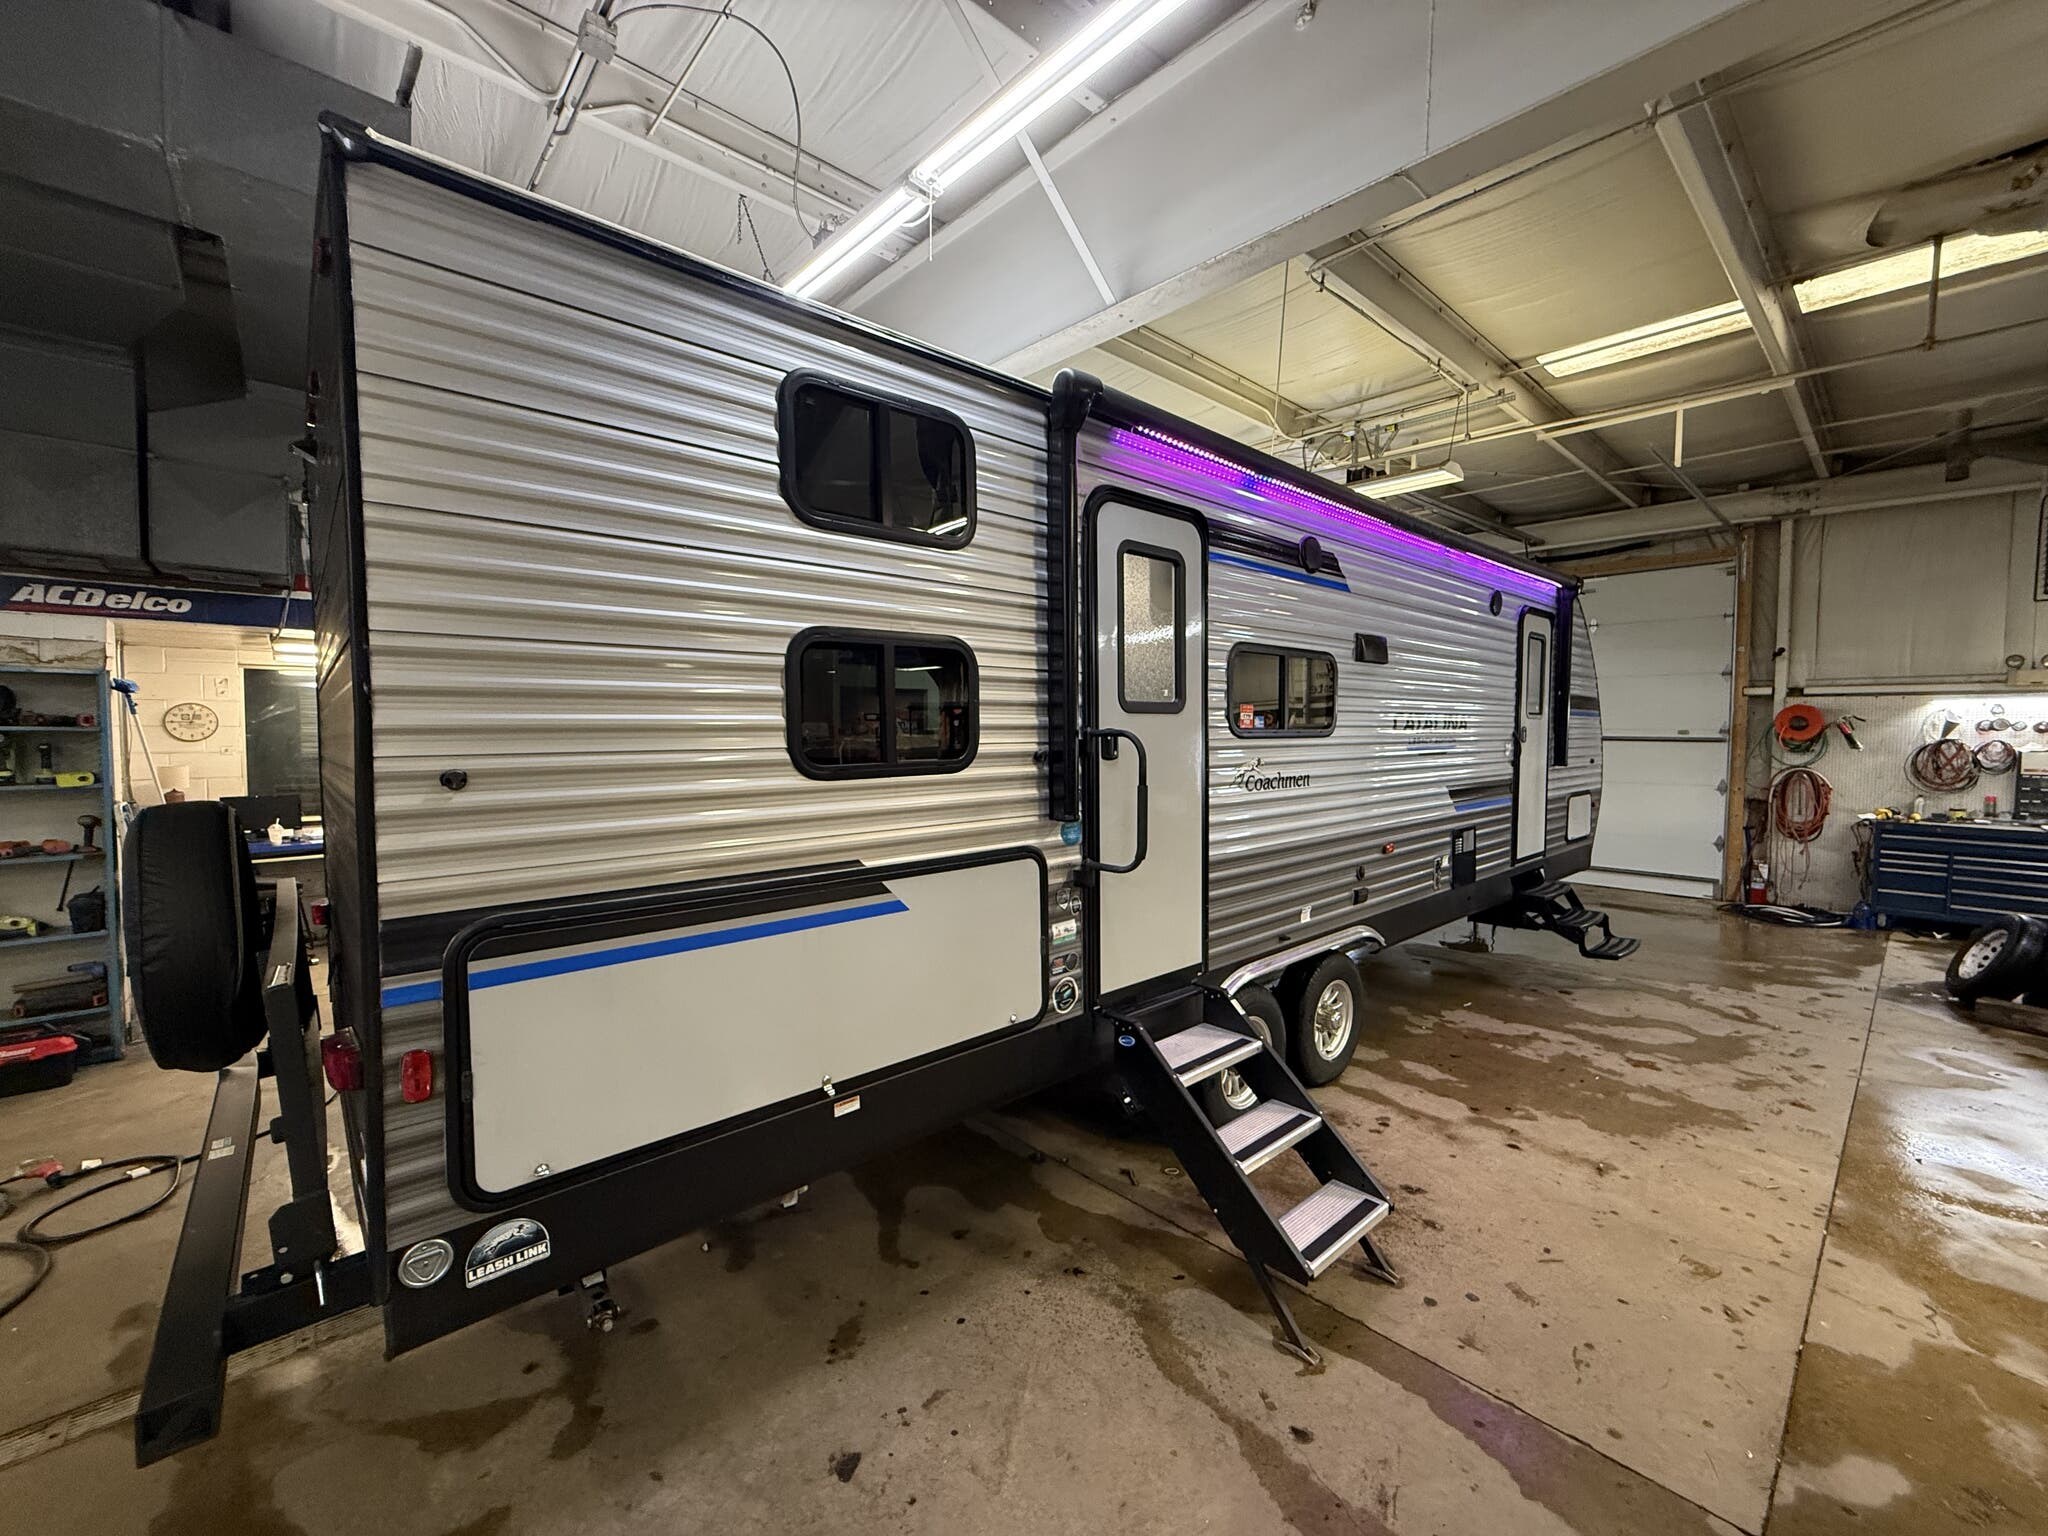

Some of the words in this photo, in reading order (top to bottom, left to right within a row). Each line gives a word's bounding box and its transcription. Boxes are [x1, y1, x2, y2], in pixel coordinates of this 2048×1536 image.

[10, 583, 192, 613] ACDelco
[1245, 772, 1310, 792] Coachmen
[468, 1256, 513, 1281] LEASH
[515, 1243, 547, 1263] LINK
